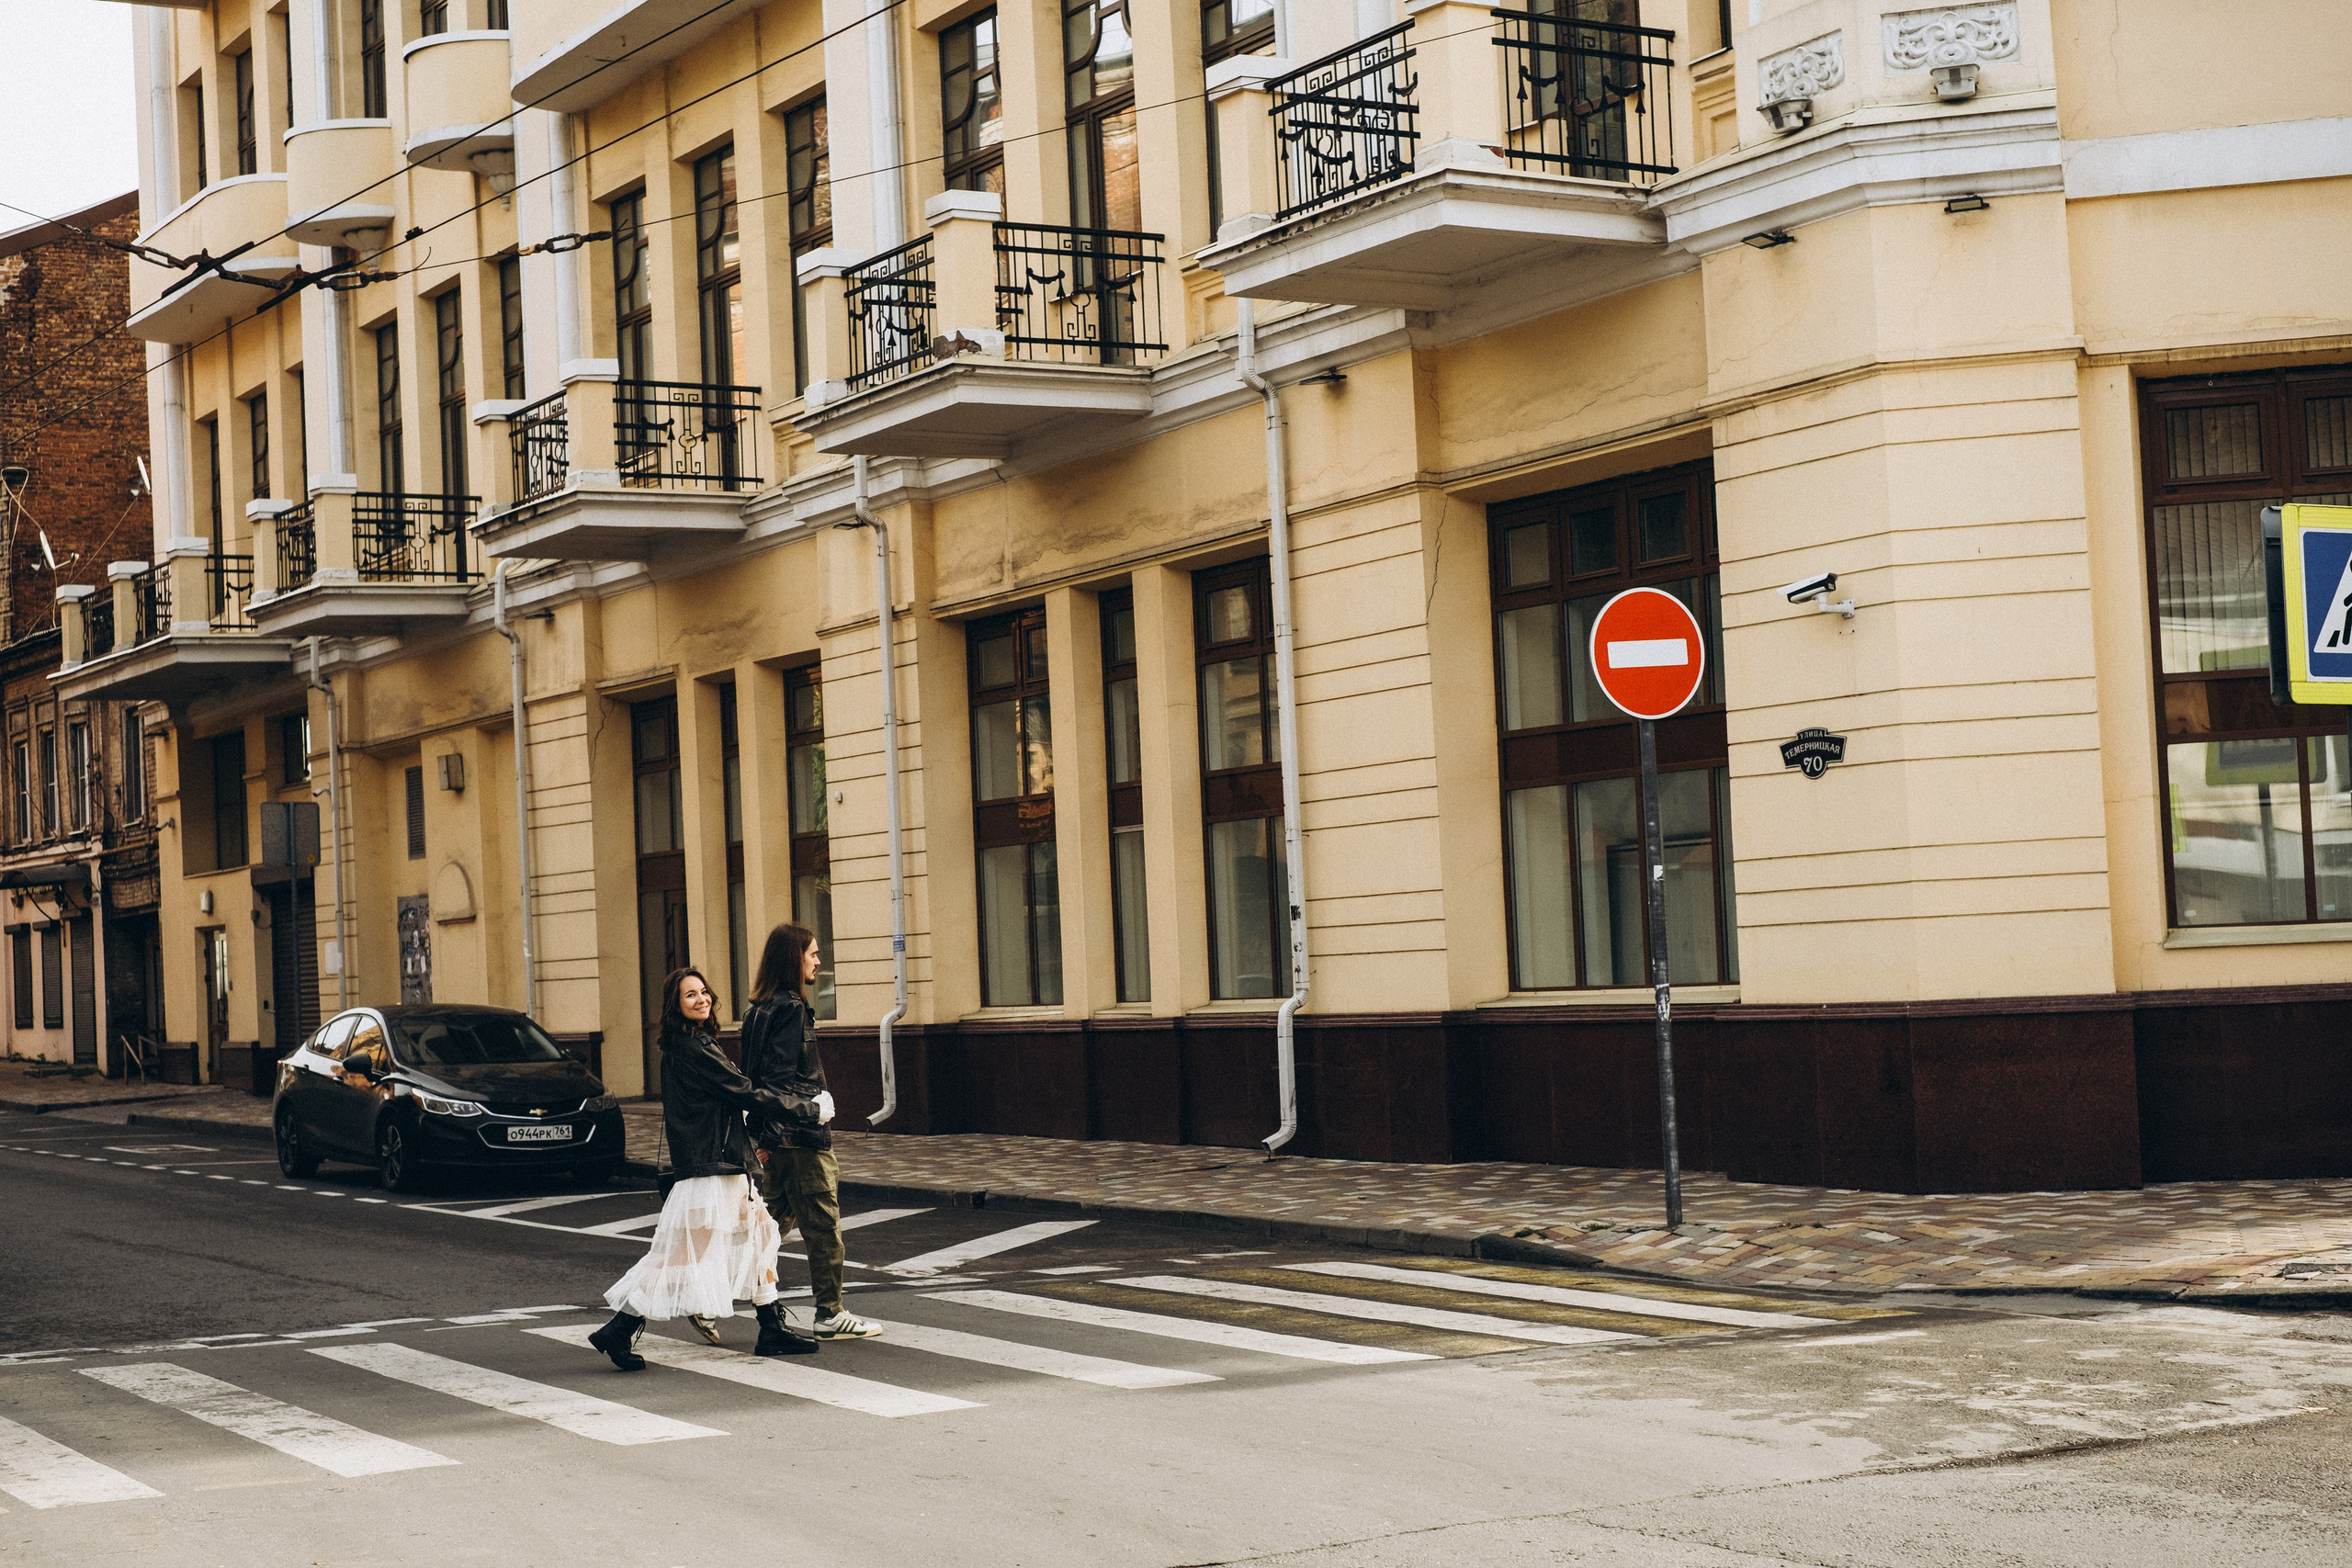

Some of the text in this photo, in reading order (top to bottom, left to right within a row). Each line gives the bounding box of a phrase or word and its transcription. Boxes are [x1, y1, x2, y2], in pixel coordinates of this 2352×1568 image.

[1800, 730, 1824, 739] УЛИЦА
[1784, 741, 1840, 760] ТЕМЕРНИЦКАЯ
[1804, 756, 1823, 773] 70
